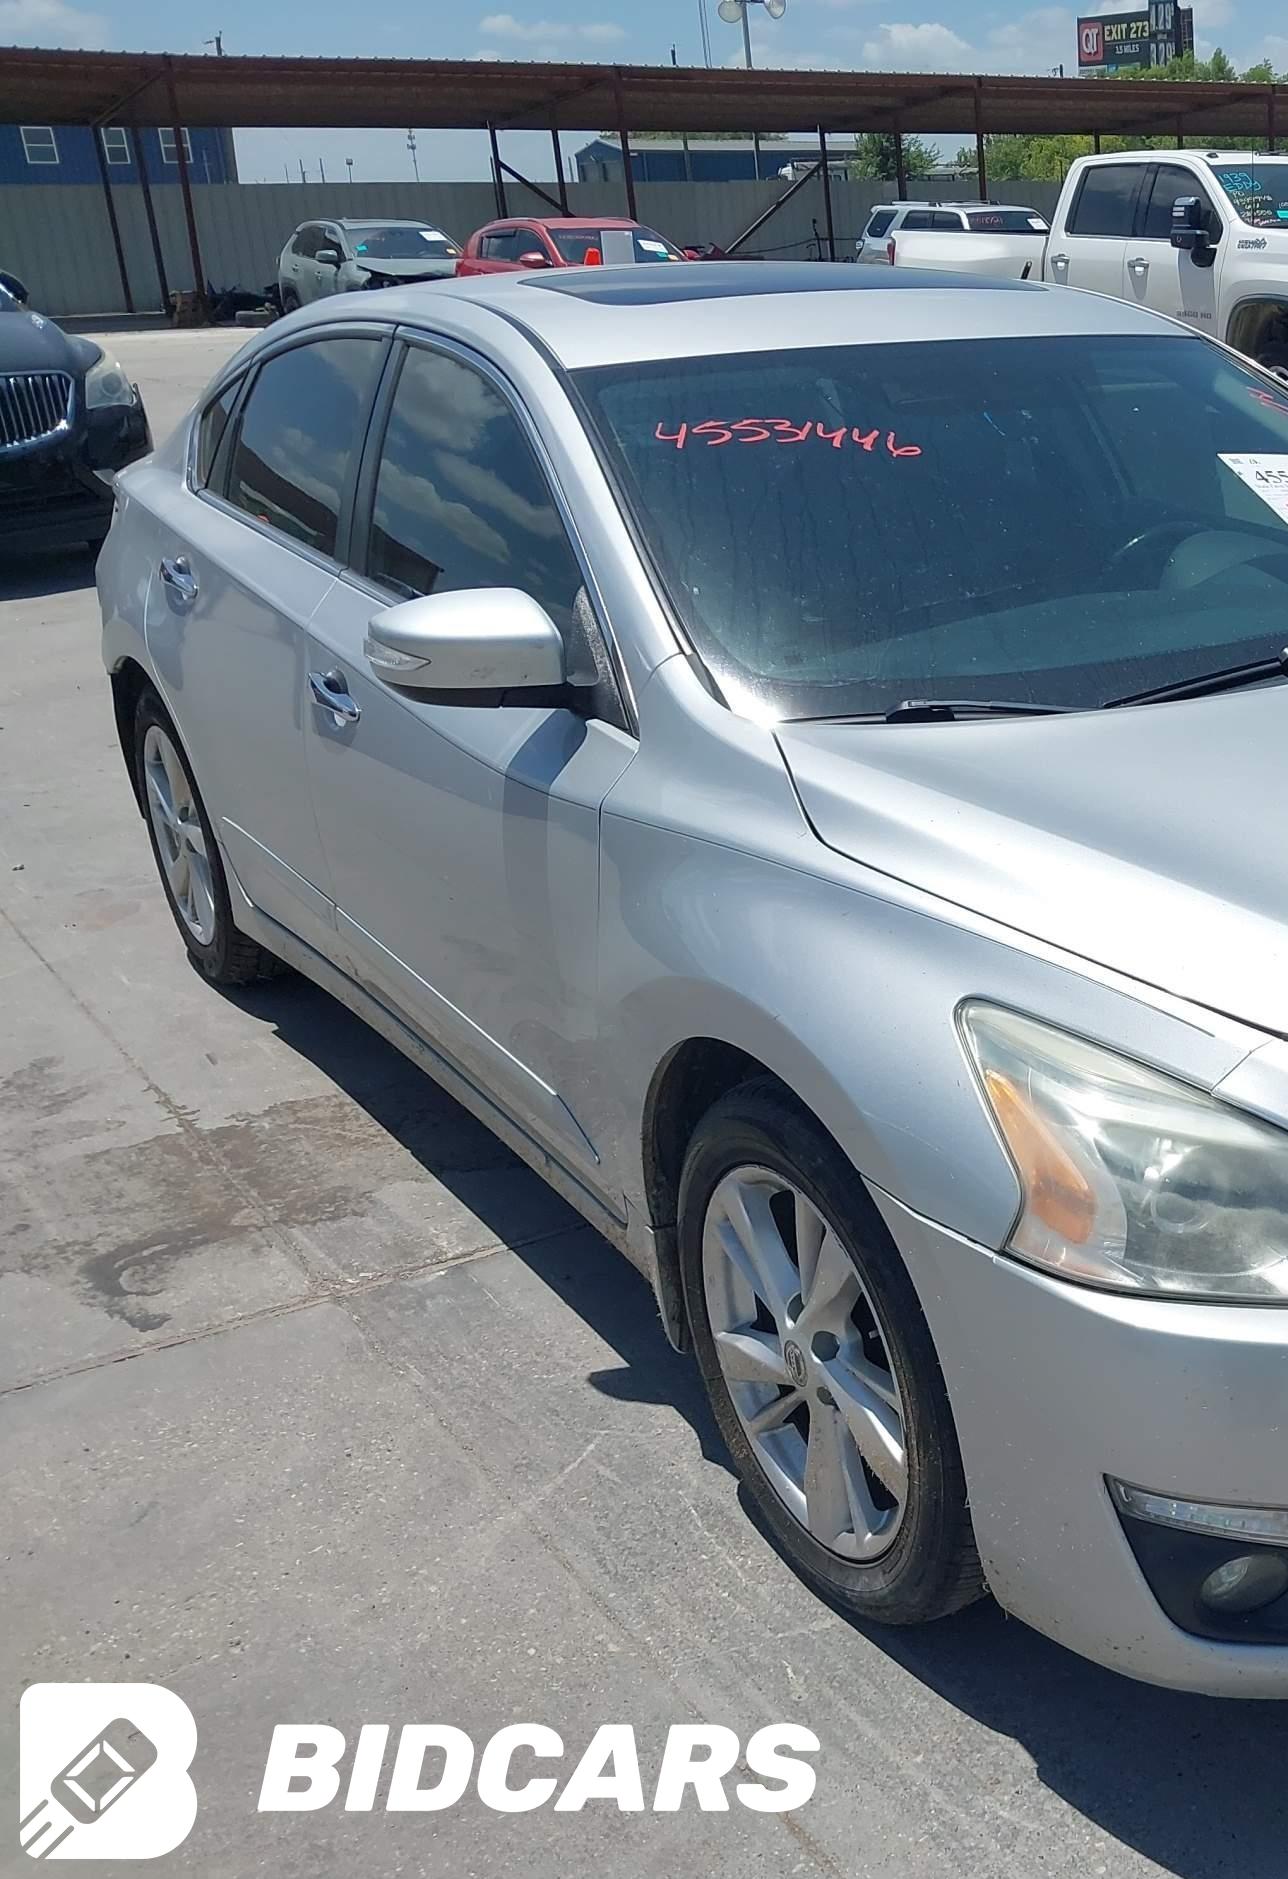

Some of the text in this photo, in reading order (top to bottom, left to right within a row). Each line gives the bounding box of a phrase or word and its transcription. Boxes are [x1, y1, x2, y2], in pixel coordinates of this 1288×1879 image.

[1083, 28, 1099, 55] QT
[1104, 21, 1149, 40] EXIT 273
[655, 419, 923, 458] 45531446
